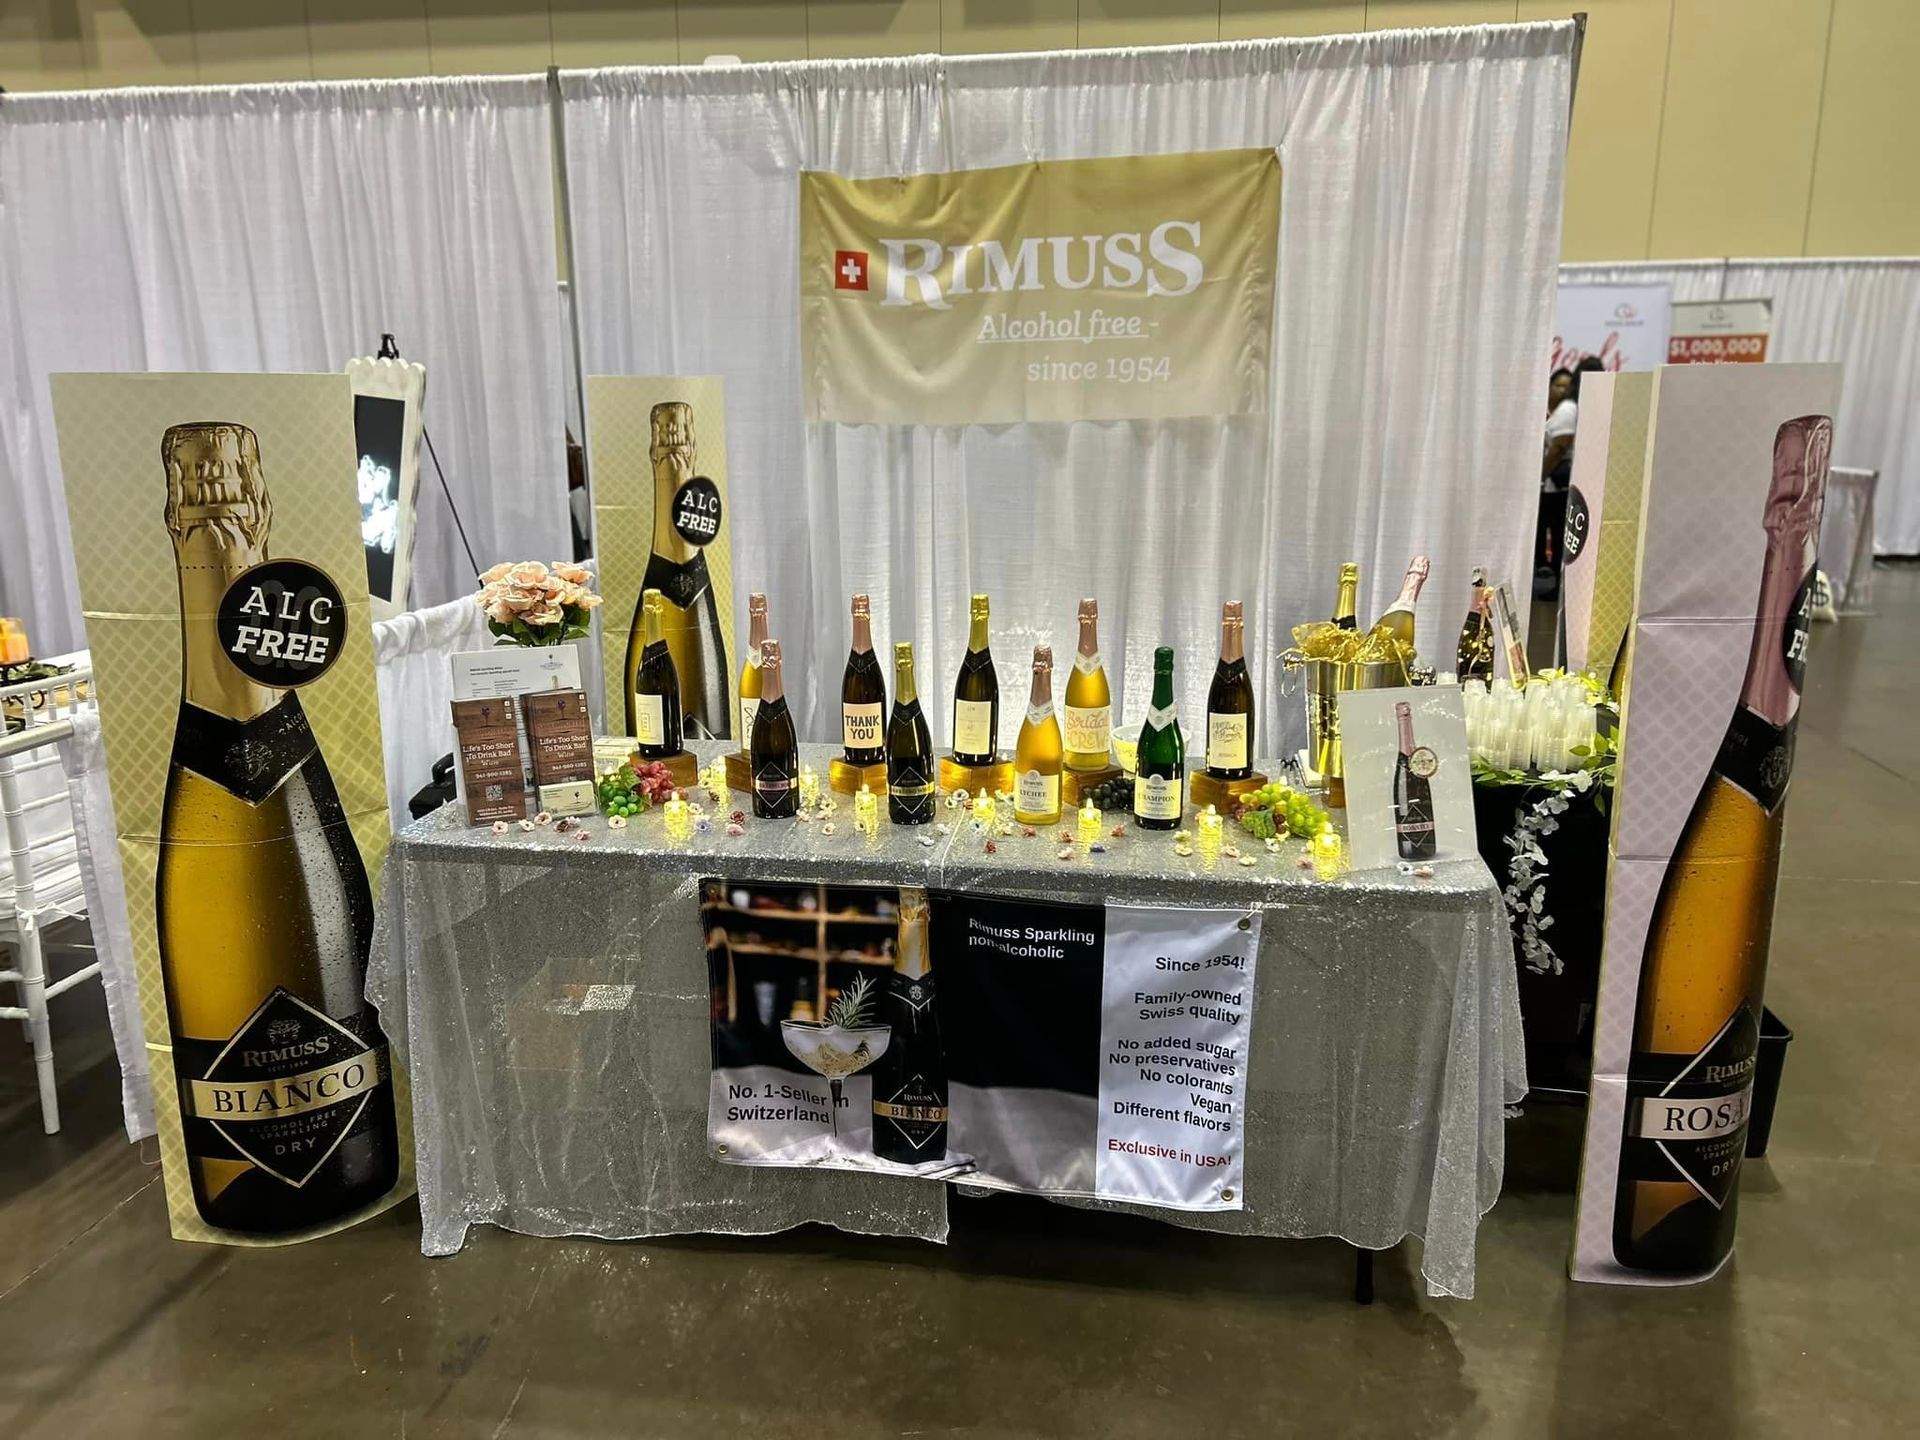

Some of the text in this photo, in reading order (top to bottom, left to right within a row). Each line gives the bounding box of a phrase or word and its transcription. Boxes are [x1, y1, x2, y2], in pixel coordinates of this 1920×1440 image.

[879, 221, 1204, 310] RIMUSS
[977, 310, 1081, 339] Alcohol
[1083, 309, 1141, 343] free
[1671, 338, 1762, 357] $1,000,000
[1027, 355, 1171, 383] since 1954
[680, 489, 718, 513] ALC
[676, 511, 717, 534] FREE
[239, 586, 333, 625] ALC
[231, 625, 330, 664] FREE
[845, 715, 880, 728] THANK
[850, 728, 875, 740] YOU
[477, 751, 498, 759] Drink
[496, 742, 514, 750] Short
[553, 744, 573, 752] Drink
[969, 917, 1095, 946] Rimuss Sparkling
[968, 935, 1065, 959] non-alcoholic
[1155, 955, 1246, 972] Since 1954!
[1134, 989, 1242, 1006] Family-owned
[1139, 1005, 1241, 1026] Swiss quality
[243, 1036, 331, 1067] RIMUSS
[1118, 1036, 1237, 1060] No added sugar
[1109, 1053, 1236, 1077] No preservatives
[212, 1064, 365, 1113] BIANCO
[1140, 1068, 1233, 1095] No colorants
[729, 1084, 758, 1099] No.
[764, 1084, 828, 1106] 1-Seller
[1190, 1093, 1232, 1114] Vegan
[310, 1110, 338, 1123] FREE
[727, 1105, 831, 1124] Switzerland
[1113, 1101, 1231, 1132] Different flavors
[260, 1120, 328, 1140] SPARKLING
[275, 1137, 316, 1155] DRY
[1108, 1139, 1231, 1168] Exclusive in USA!
